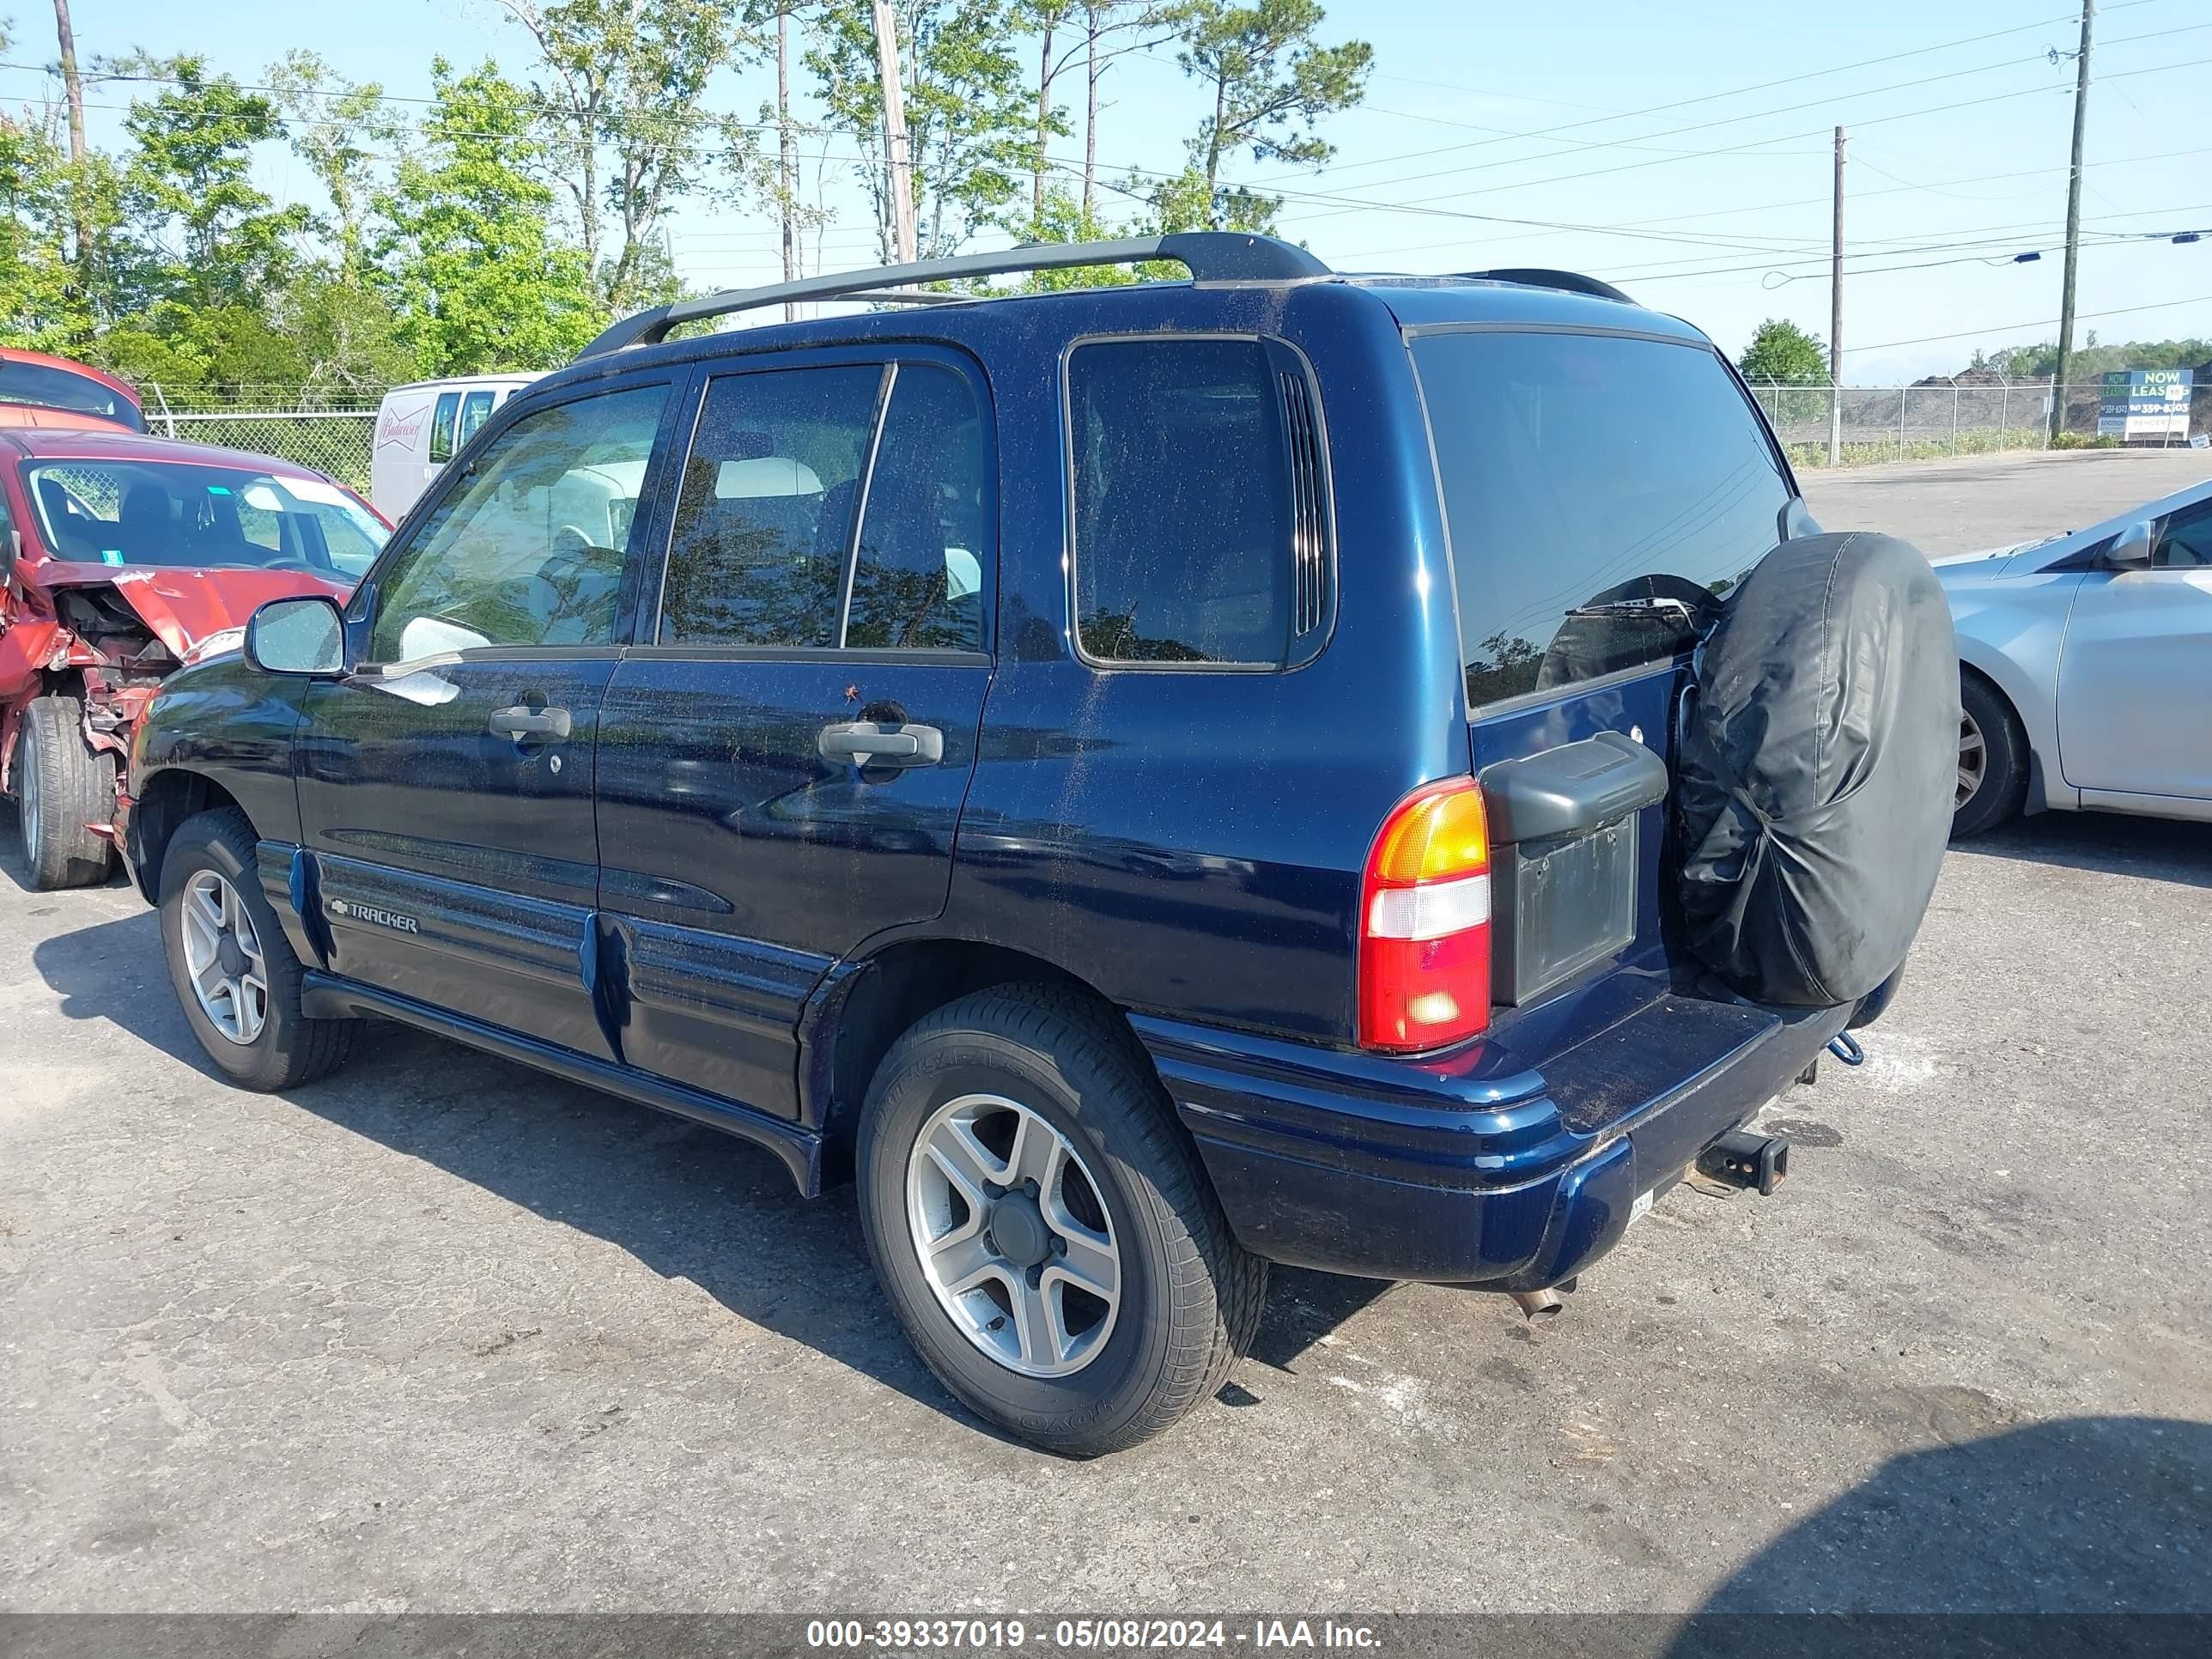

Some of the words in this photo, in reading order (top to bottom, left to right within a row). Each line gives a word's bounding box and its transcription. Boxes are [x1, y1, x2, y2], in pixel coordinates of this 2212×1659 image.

[2108, 374, 2125, 384] NOW
[2144, 372, 2180, 384] NOW
[2132, 386, 2190, 397] LEASG
[383, 417, 420, 438] Budweiser
[350, 904, 417, 934] TRACKER
